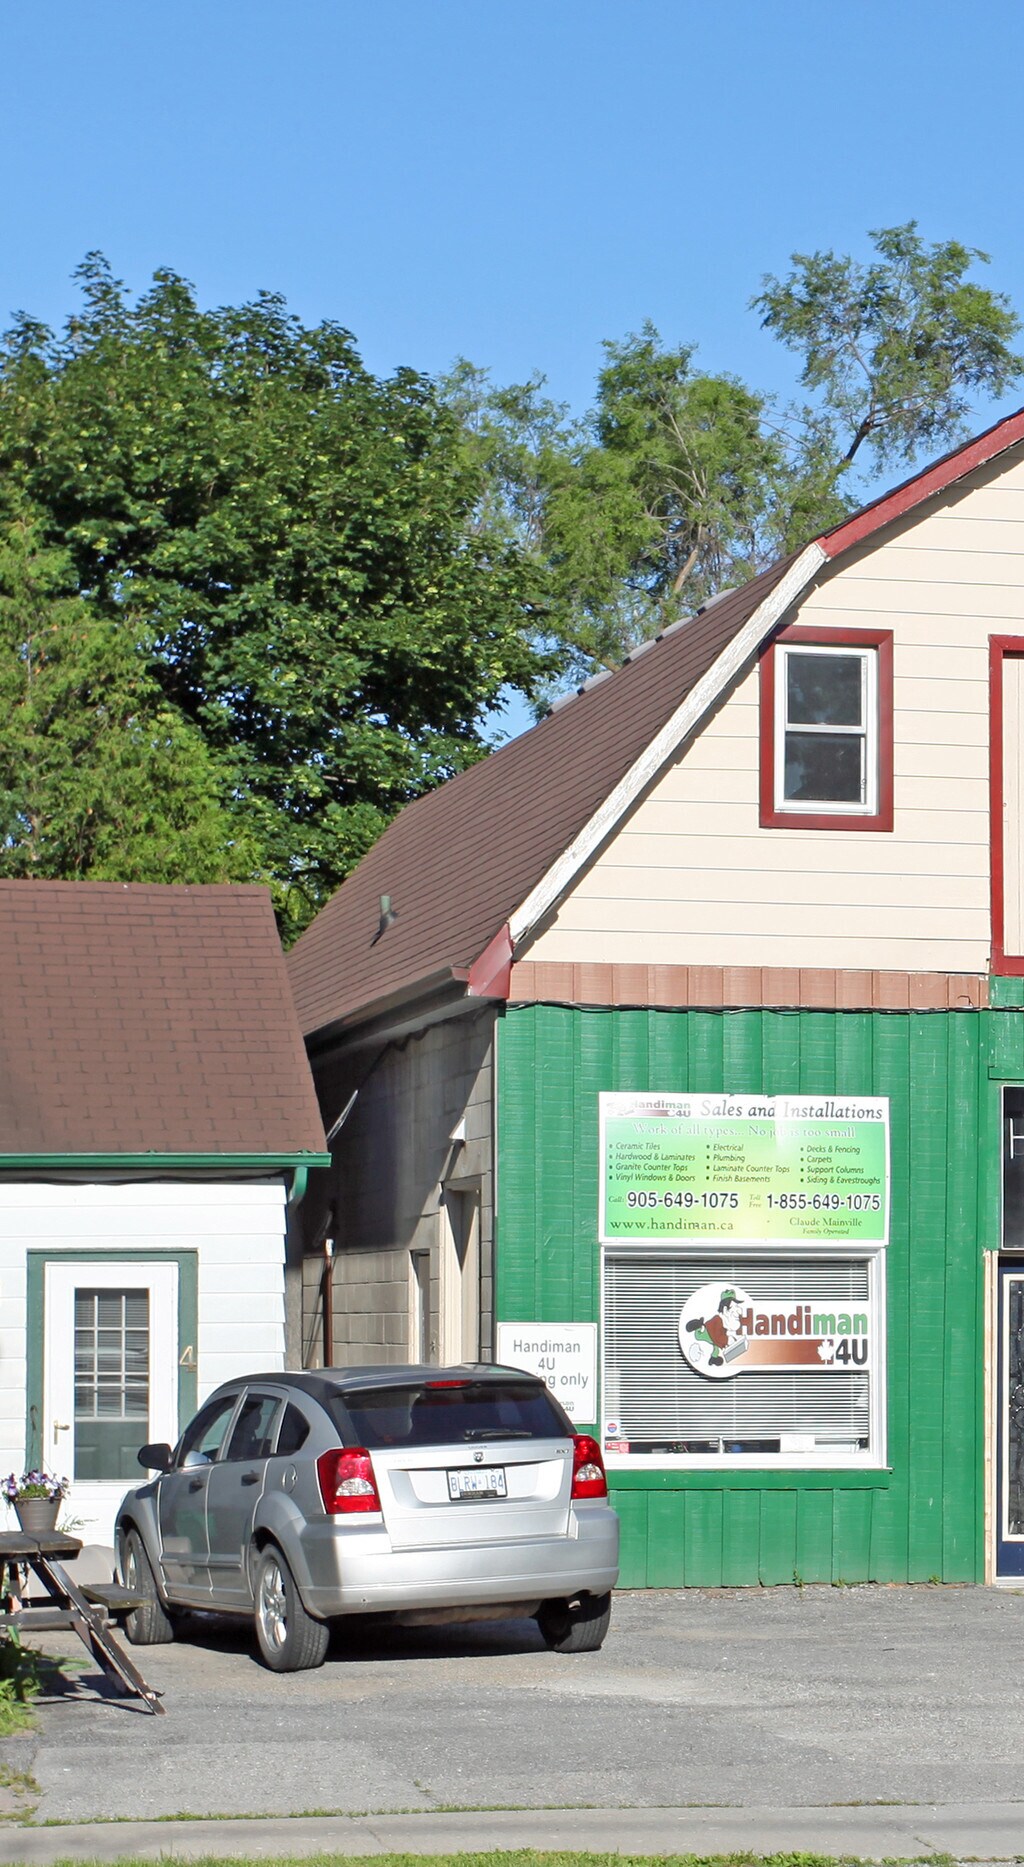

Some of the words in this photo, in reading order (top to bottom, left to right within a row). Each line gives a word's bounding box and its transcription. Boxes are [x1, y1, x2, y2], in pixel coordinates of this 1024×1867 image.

[700, 1100, 743, 1116] Sales
[748, 1101, 777, 1117] and
[784, 1101, 883, 1119] Installations
[633, 1123, 667, 1135] Work
[671, 1124, 684, 1135] of
[687, 1124, 700, 1135] all
[749, 1125, 766, 1136] No
[803, 1128, 822, 1137] too
[825, 1127, 855, 1138] small
[615, 1142, 644, 1150] Ceramic
[645, 1142, 661, 1150] Tiles
[713, 1143, 744, 1151] Electrical
[807, 1145, 826, 1153] Decks
[835, 1146, 861, 1155] Fencing
[713, 1154, 745, 1163] Plumbing
[807, 1156, 832, 1164] Carpets
[615, 1163, 641, 1171] Granite
[643, 1163, 671, 1171] Counter
[673, 1163, 688, 1172] Tops
[713, 1164, 743, 1172] Laminate
[746, 1165, 773, 1173] Counter
[775, 1165, 790, 1173] Tops
[807, 1166, 834, 1174] Support
[836, 1166, 864, 1174] Columns
[615, 1173, 633, 1182] Vinyl
[635, 1173, 666, 1181] Windows
[668, 1173, 674, 1181] &
[713, 1174, 733, 1182] Finish
[734, 1175, 771, 1183] Basements
[807, 1176, 828, 1185] Siding
[627, 1192, 739, 1208] 905-649-1075
[767, 1193, 880, 1210] 1-855-649-1075
[610, 1217, 734, 1231] www.handiman.ca
[789, 1217, 820, 1227] Claude
[822, 1217, 863, 1227] Mainville
[736, 1305, 868, 1335] Handiman
[513, 1339, 581, 1353] Handiman
[835, 1339, 868, 1365] 4U
[180, 1346, 197, 1371] 4
[538, 1357, 555, 1370] 4U
[560, 1373, 589, 1389] only
[485, 1474, 504, 1489] 184
